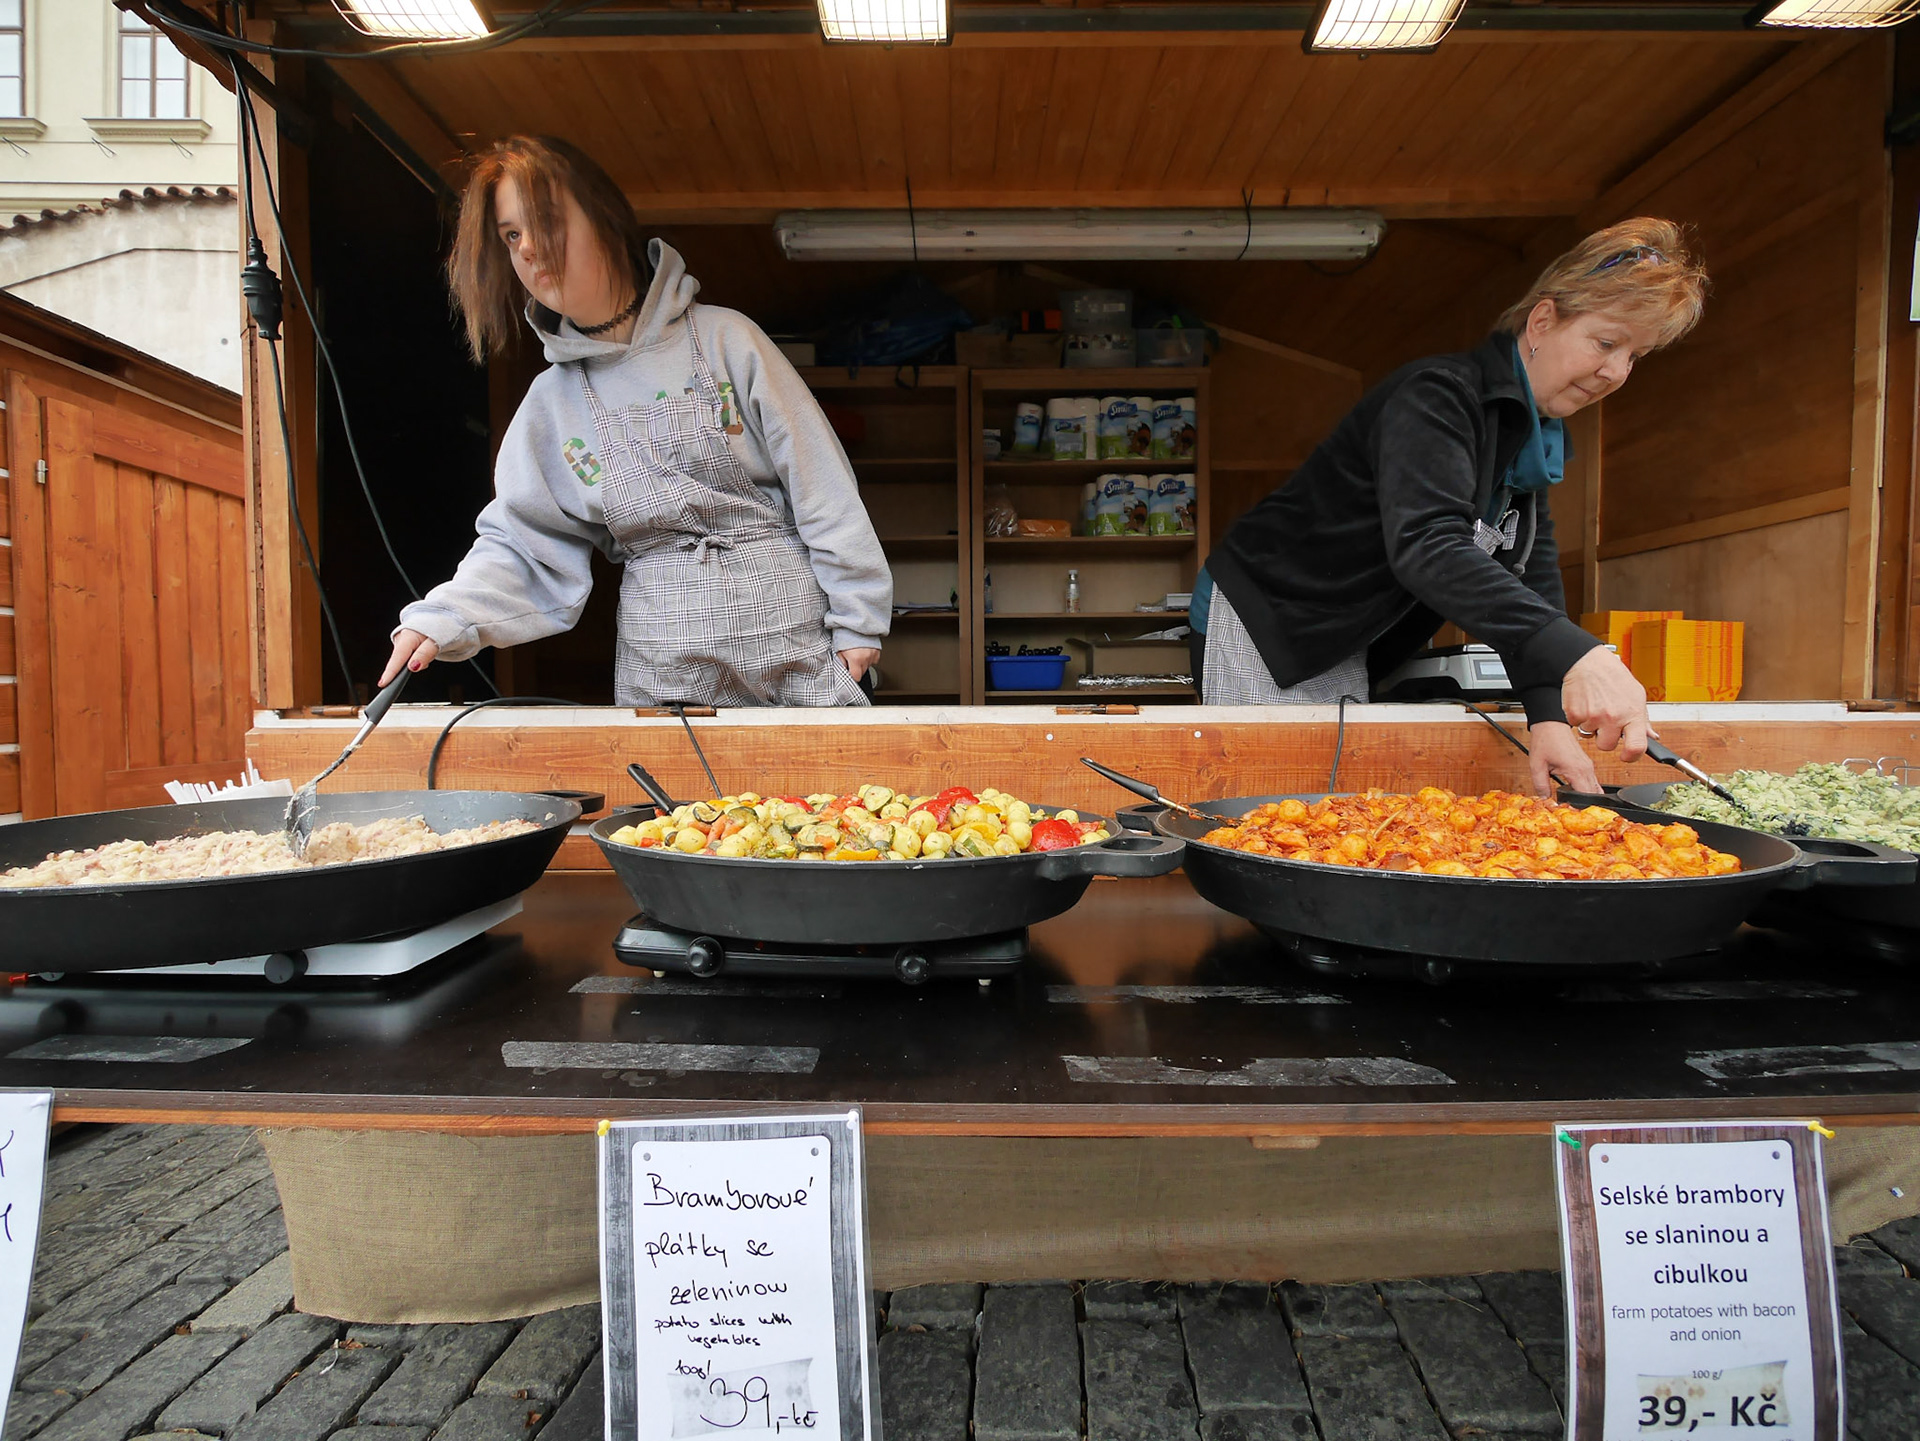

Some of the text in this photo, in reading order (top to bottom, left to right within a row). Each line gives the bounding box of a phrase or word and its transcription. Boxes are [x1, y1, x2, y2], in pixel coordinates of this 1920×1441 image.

[1110, 402, 1132, 416] Smile
[1107, 480, 1130, 494] Smile
[643, 1173, 813, 1210] Bramborové
[1600, 1184, 1784, 1207] Selské brambory
[1625, 1224, 1769, 1245] se slaninou a
[645, 1232, 774, 1268] plátky se
[1654, 1263, 1747, 1284] cibulkou
[709, 1313, 746, 1327] slices
[758, 1315, 792, 1326] with
[1612, 1303, 1795, 1322] farm potatoes with bacon
[687, 1334, 761, 1348] vegetables
[1670, 1328, 1741, 1341] and onion
[1692, 1370, 1709, 1379] 100
[1638, 1392, 1776, 1432] 39,- Kč
